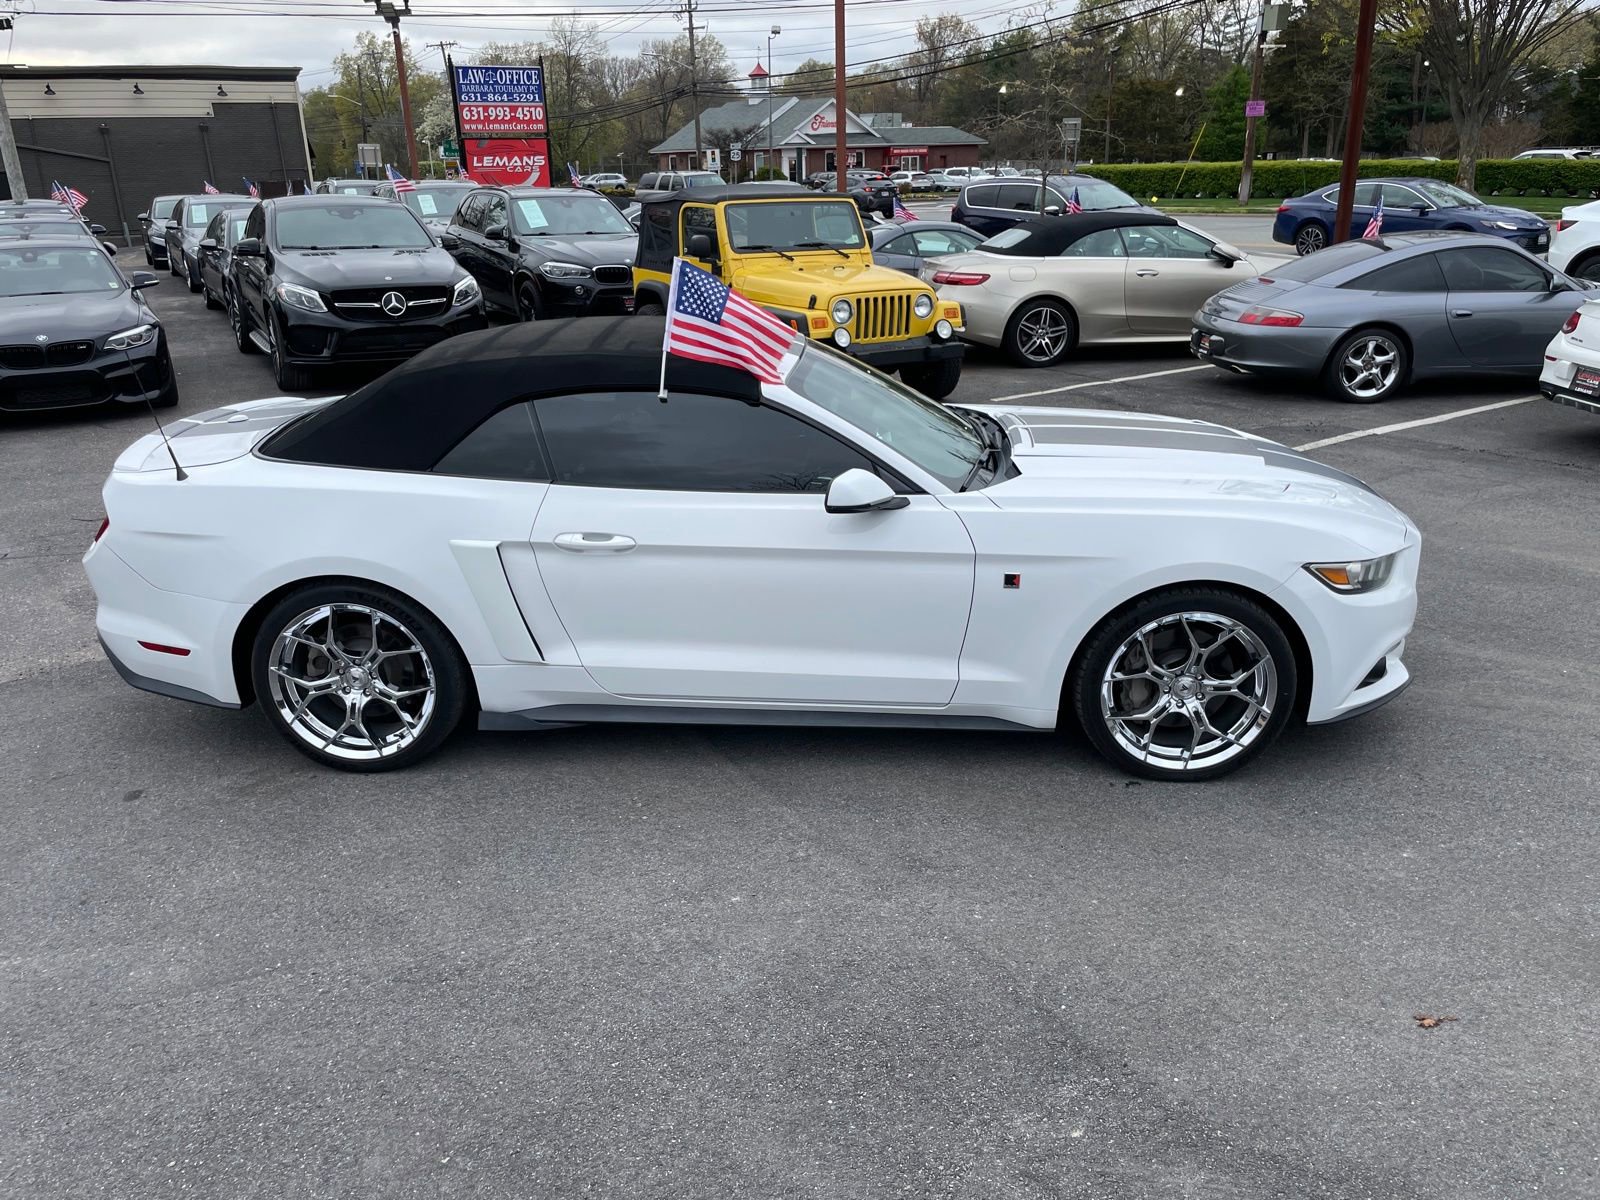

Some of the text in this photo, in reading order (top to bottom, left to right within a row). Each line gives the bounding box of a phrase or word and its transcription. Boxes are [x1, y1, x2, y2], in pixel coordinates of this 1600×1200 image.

[459, 69, 539, 84] LAW OFFICE
[461, 84, 494, 92] BARBARA
[494, 85, 529, 93] TOUHAMY
[461, 93, 540, 102] 631-864-5291
[463, 107, 543, 120] 631-993-4510
[731, 151, 741, 159] 25
[473, 156, 545, 166] LEMANS
